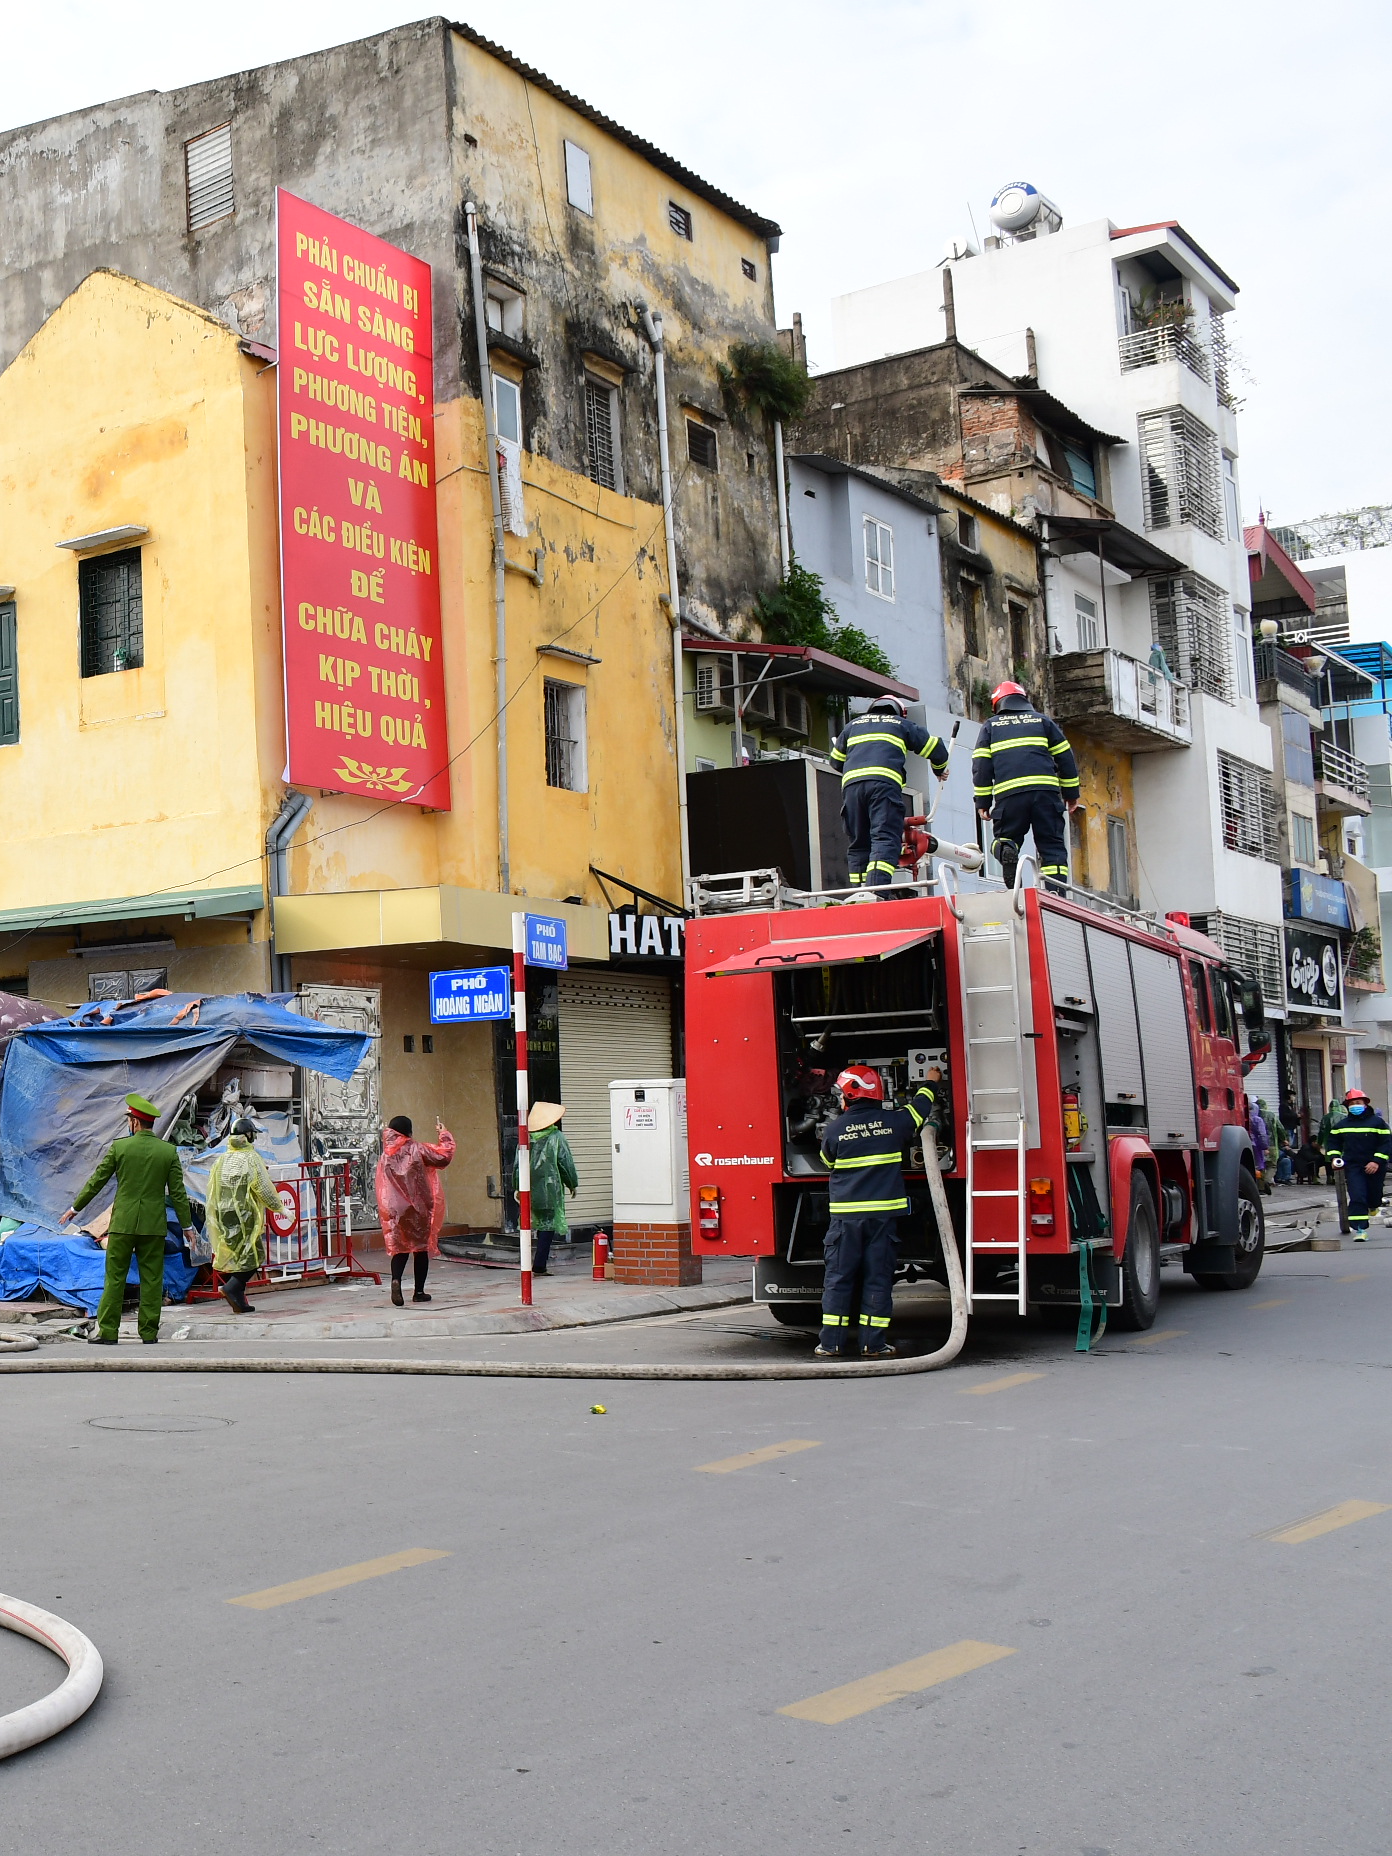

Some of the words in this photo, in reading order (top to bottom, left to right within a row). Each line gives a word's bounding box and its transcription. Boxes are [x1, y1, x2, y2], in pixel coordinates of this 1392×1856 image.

[295, 231, 338, 275] PHẢI
[343, 255, 399, 304] CHUẨN
[403, 281, 419, 318] BỊ
[303, 279, 351, 325] SẴN
[358, 305, 415, 355] SÀNG
[294, 321, 340, 362] LỰC
[347, 343, 426, 405] LƯỢNG,
[293, 367, 377, 424] PHƯƠNG
[382, 401, 428, 449] TIỆN,
[290, 411, 391, 474] PHƯƠNG
[398, 448, 429, 489] ÁN
[348, 477, 383, 514] VÀ
[293, 506, 336, 544] CÁC
[341, 520, 385, 559] ĐIỀU
[390, 533, 431, 576] KIỆN
[350, 567, 386, 605] ĐỂ
[298, 602, 368, 645] CHỮA
[374, 622, 434, 662] CHÁY
[319, 653, 361, 691] KỊP
[314, 700, 372, 740] HIỆU
[380, 713, 428, 750] QUẢ
[535, 922, 556, 938] PHỐ
[609, 913, 685, 956] HAT
[531, 941, 546, 961] TAM
[547, 943, 562, 965] BẠC
[1290, 947, 1320, 995] Enjoy
[451, 973, 488, 991] PHỐ
[435, 995, 470, 1017] HOÀNG
[473, 991, 503, 1014] NGÂN
[838, 1132, 858, 1141] PCCC
[860, 1129, 871, 1138] VÀ
[872, 1127, 893, 1136] CNCH
[845, 1123, 867, 1132] CẢNH
[868, 1121, 883, 1129] SÁT
[714, 1154, 775, 1166] rosenbauer
